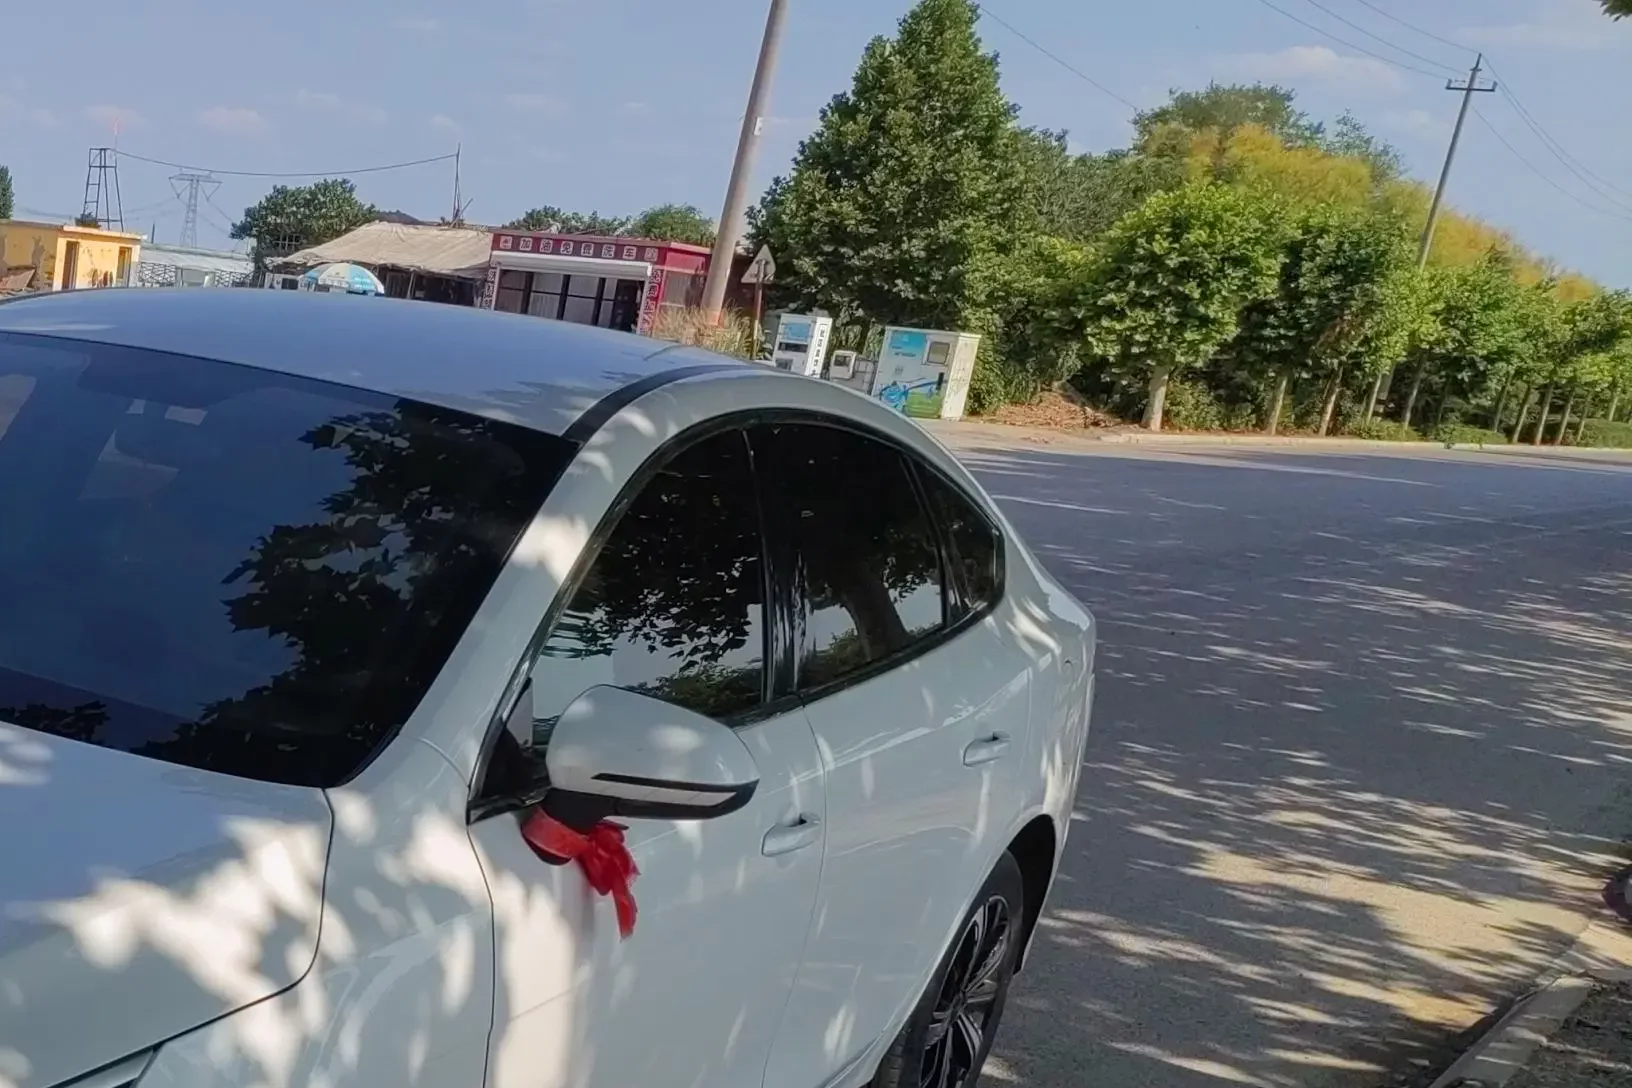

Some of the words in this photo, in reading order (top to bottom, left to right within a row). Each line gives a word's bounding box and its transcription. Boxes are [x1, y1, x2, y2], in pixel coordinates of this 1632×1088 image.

[520, 237, 636, 259] 加油免费洗车
